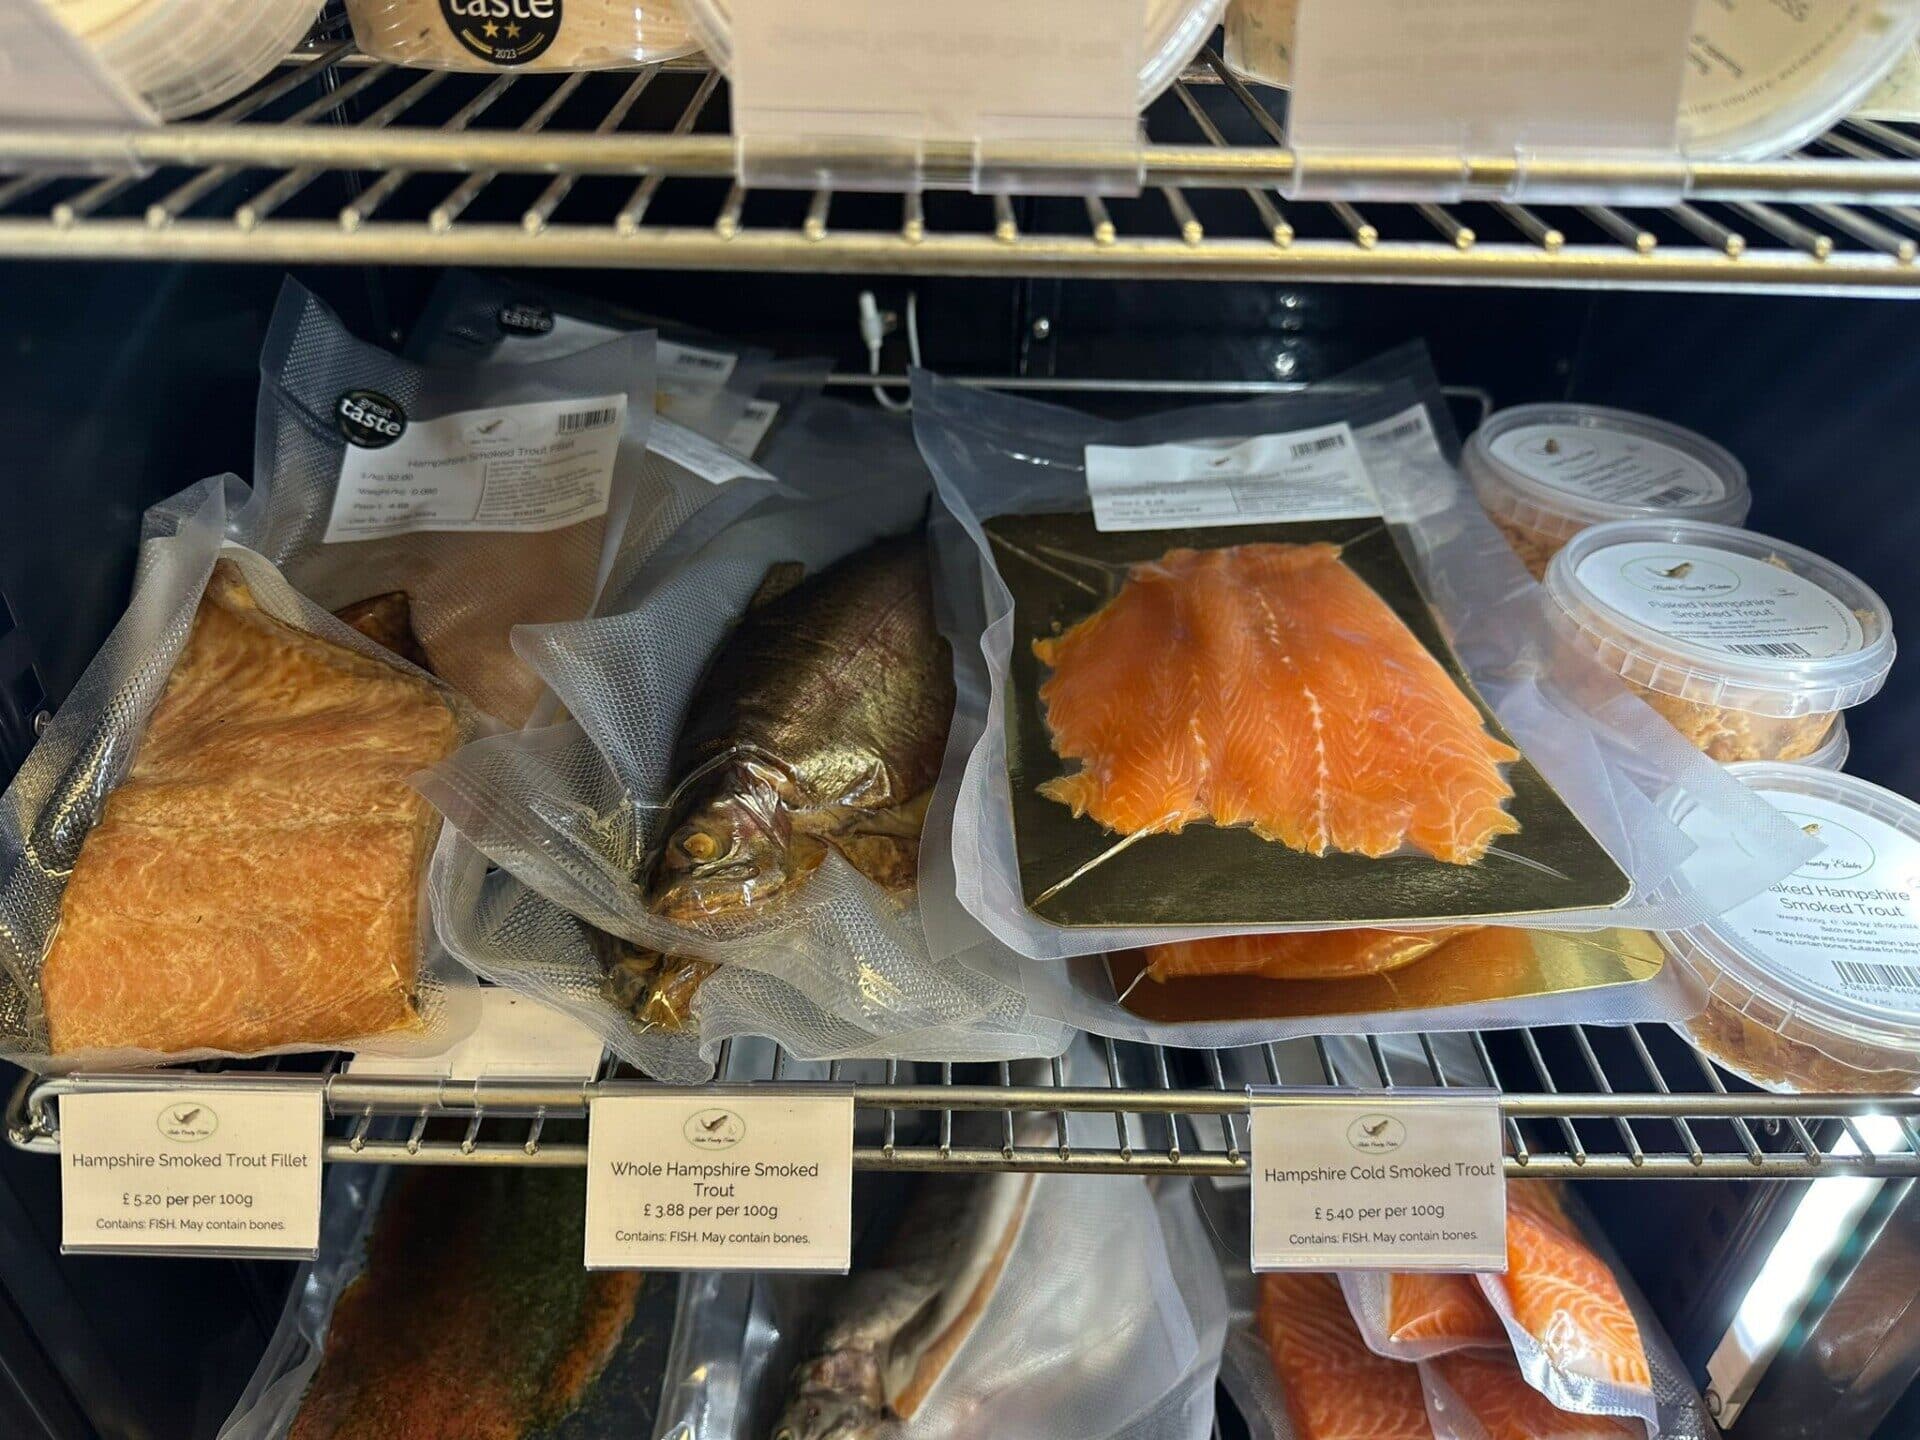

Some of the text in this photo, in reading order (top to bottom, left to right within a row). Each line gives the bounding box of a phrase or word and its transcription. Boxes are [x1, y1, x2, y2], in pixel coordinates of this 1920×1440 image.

[450, 0, 554, 19] taste
[495, 49, 517, 58] 2023
[341, 398, 401, 437] taste
[1701, 599, 1776, 609] Hampshire
[1671, 609, 1774, 618] Smoked Trout
[1806, 861, 1829, 870] ountry
[1769, 882, 1910, 901] aked Hampshire
[1780, 897, 1905, 917] Smoked Trout
[72, 1152, 309, 1170] Hampshire Smoked Trout Fillet
[611, 1161, 819, 1179] Whole Hampshire Smoked
[1265, 1161, 1497, 1184] Hampshire Cold Smoked Trout
[693, 1182, 735, 1198] Trout
[123, 1193, 253, 1208] £ 5.20 per per 100g
[643, 1204, 778, 1220] £ 3.88 per per 100g
[1314, 1204, 1445, 1222] £ 5.40 per per 100g
[96, 1218, 285, 1232] Contains: FISH. May contain bones.
[615, 1230, 810, 1245] Contains: FISH. May contain bones.
[1289, 1229, 1478, 1245] Contains: FISH. May contain bones.
